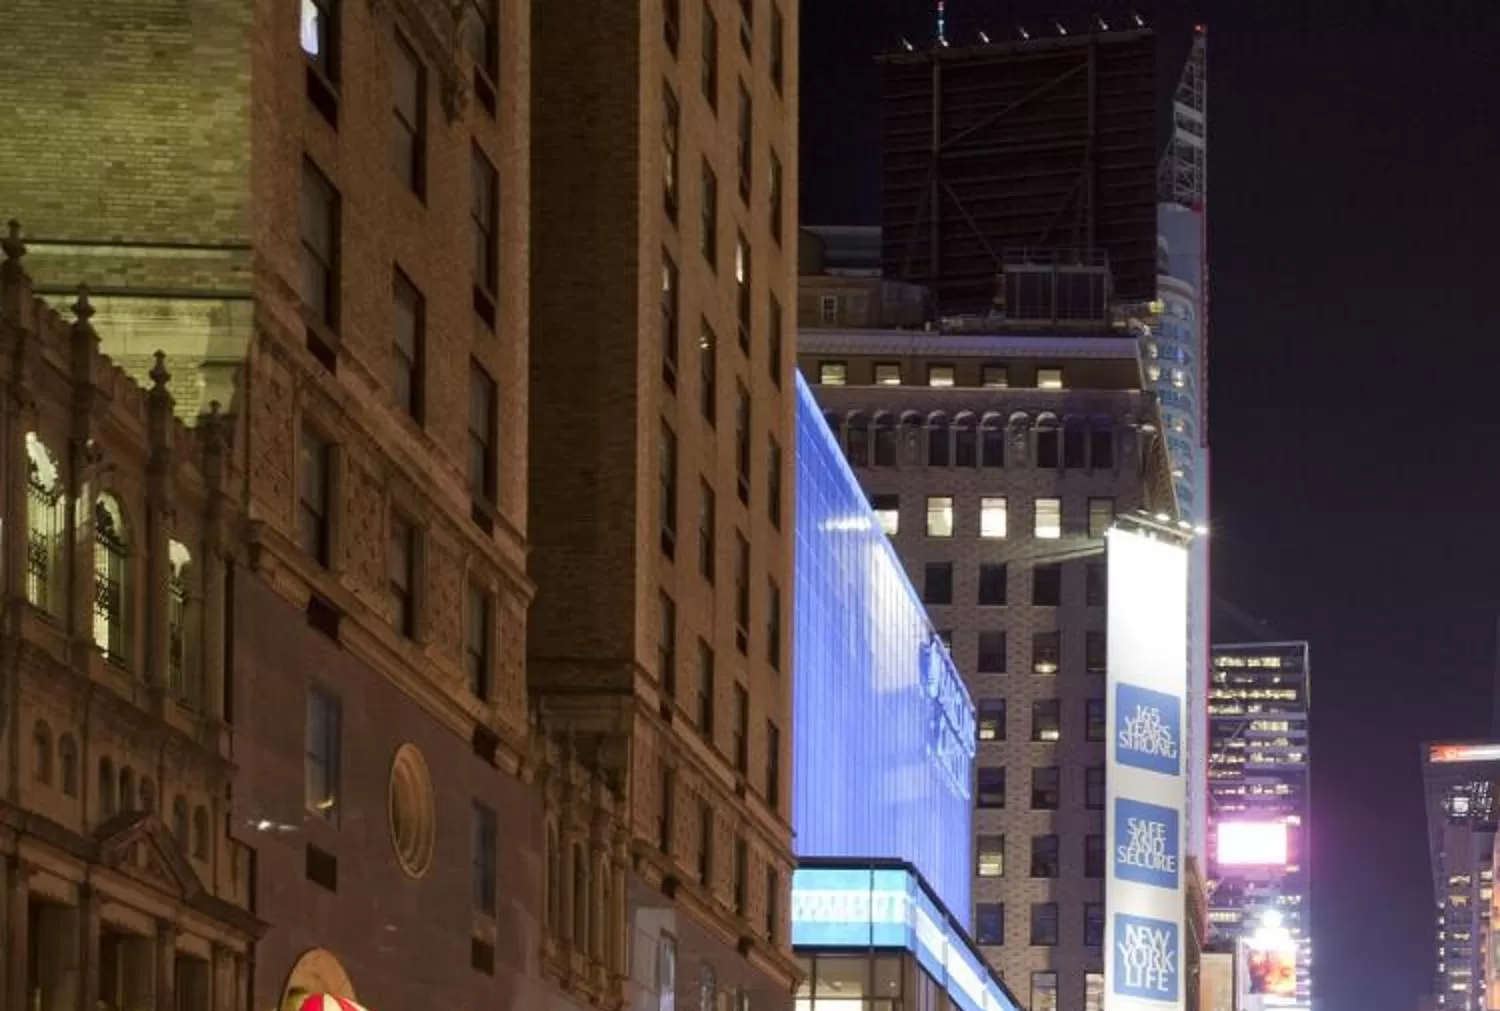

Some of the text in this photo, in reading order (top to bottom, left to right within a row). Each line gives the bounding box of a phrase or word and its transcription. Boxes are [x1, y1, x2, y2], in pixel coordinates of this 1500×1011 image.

[1127, 817, 1167, 841] SAFE
[1128, 833, 1166, 854] AND
[1117, 847, 1176, 873] SECURE
[1124, 924, 1171, 950] NEW
[1117, 939, 1175, 974] YORK
[1125, 964, 1169, 992] LIFE
